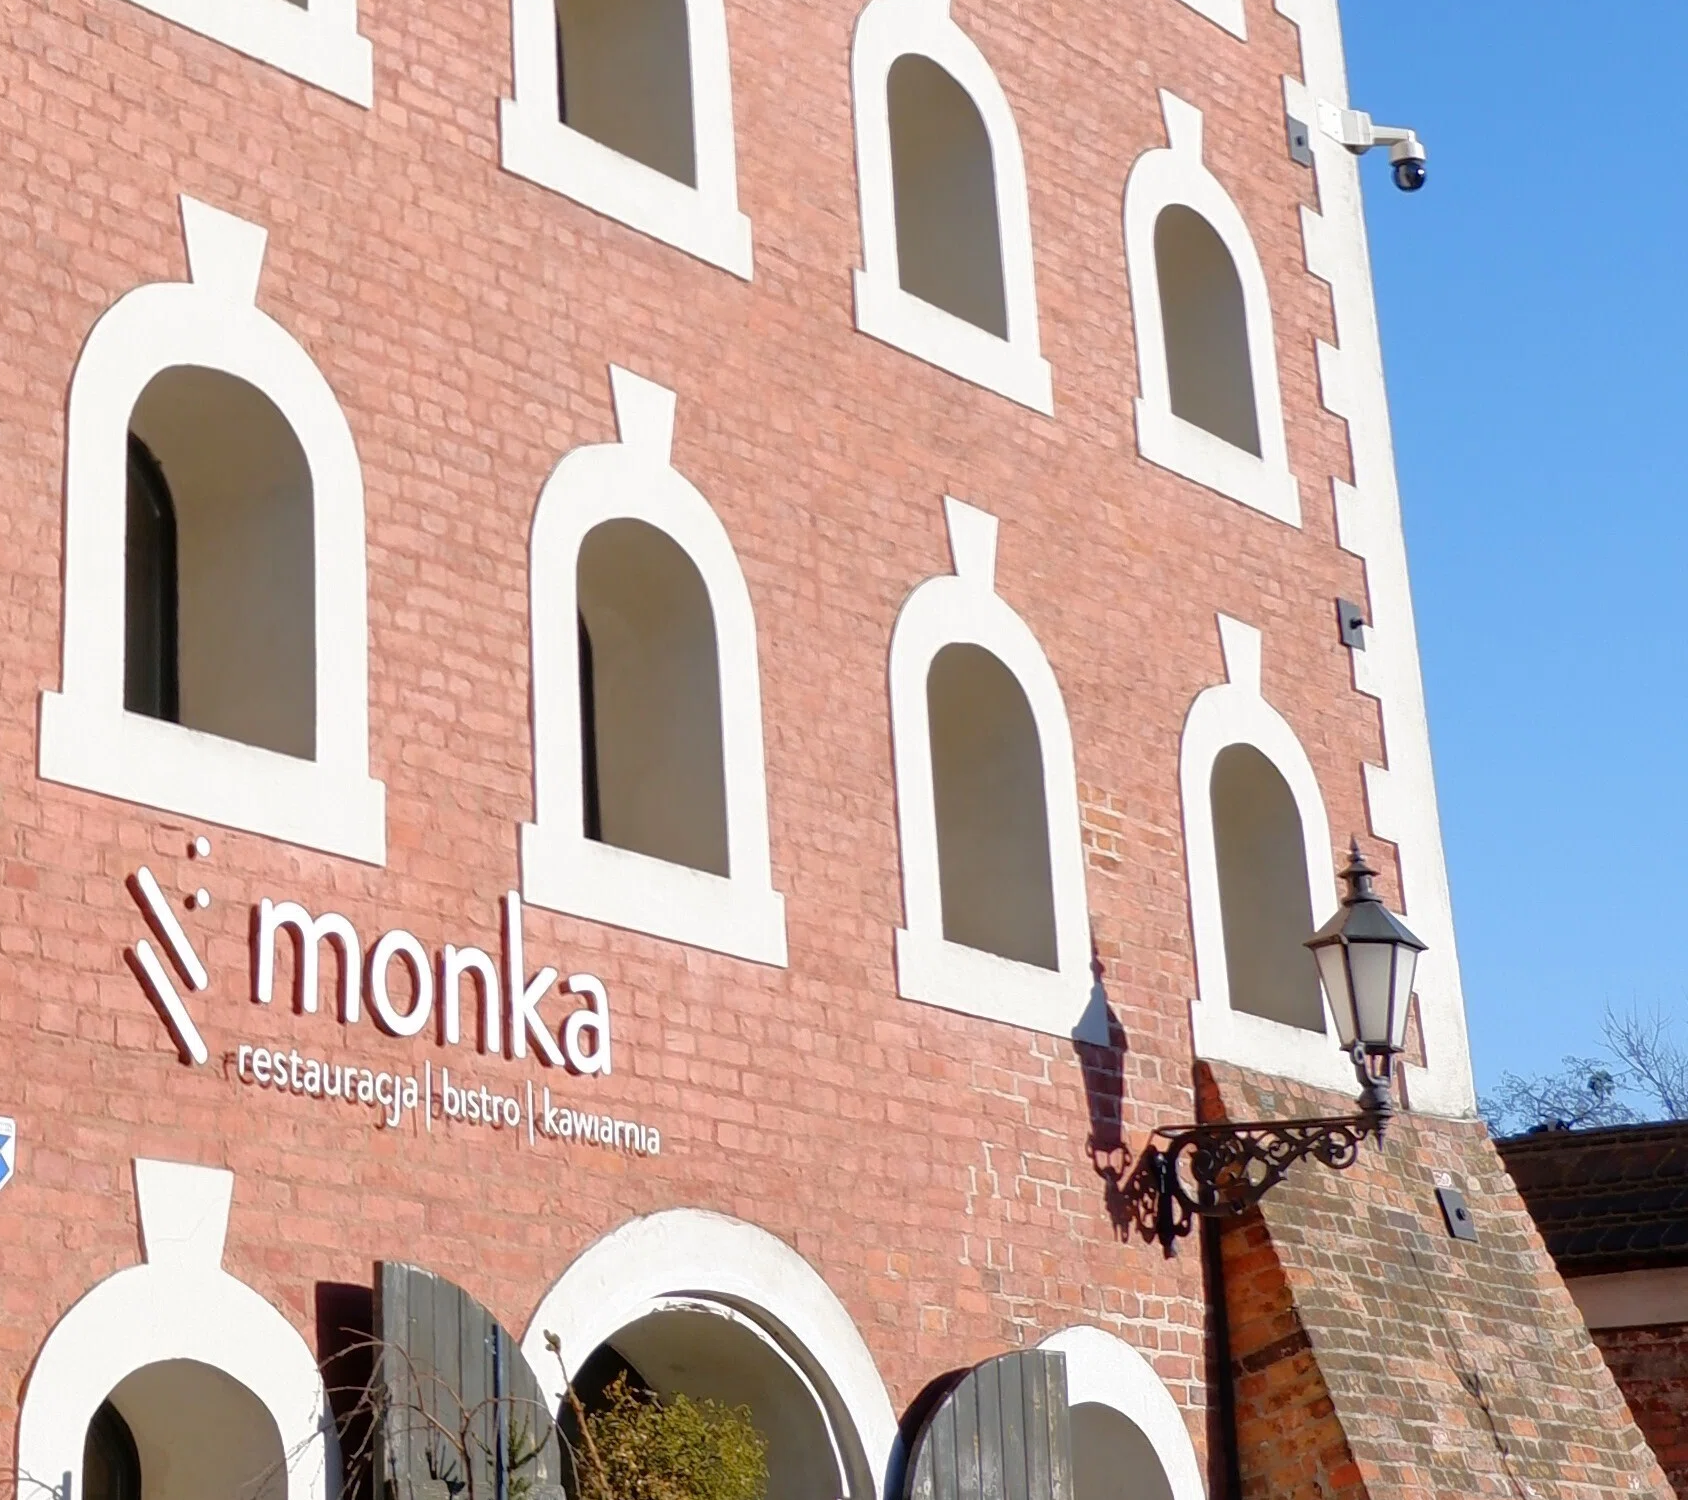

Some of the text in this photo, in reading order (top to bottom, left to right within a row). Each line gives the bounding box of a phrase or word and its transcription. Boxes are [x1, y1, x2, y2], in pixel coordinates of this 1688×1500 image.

[258, 890, 612, 1076] monka
[238, 1044, 418, 1128] restauracja
[442, 1067, 521, 1127] bistro
[543, 1086, 661, 1155] kawiarnia
